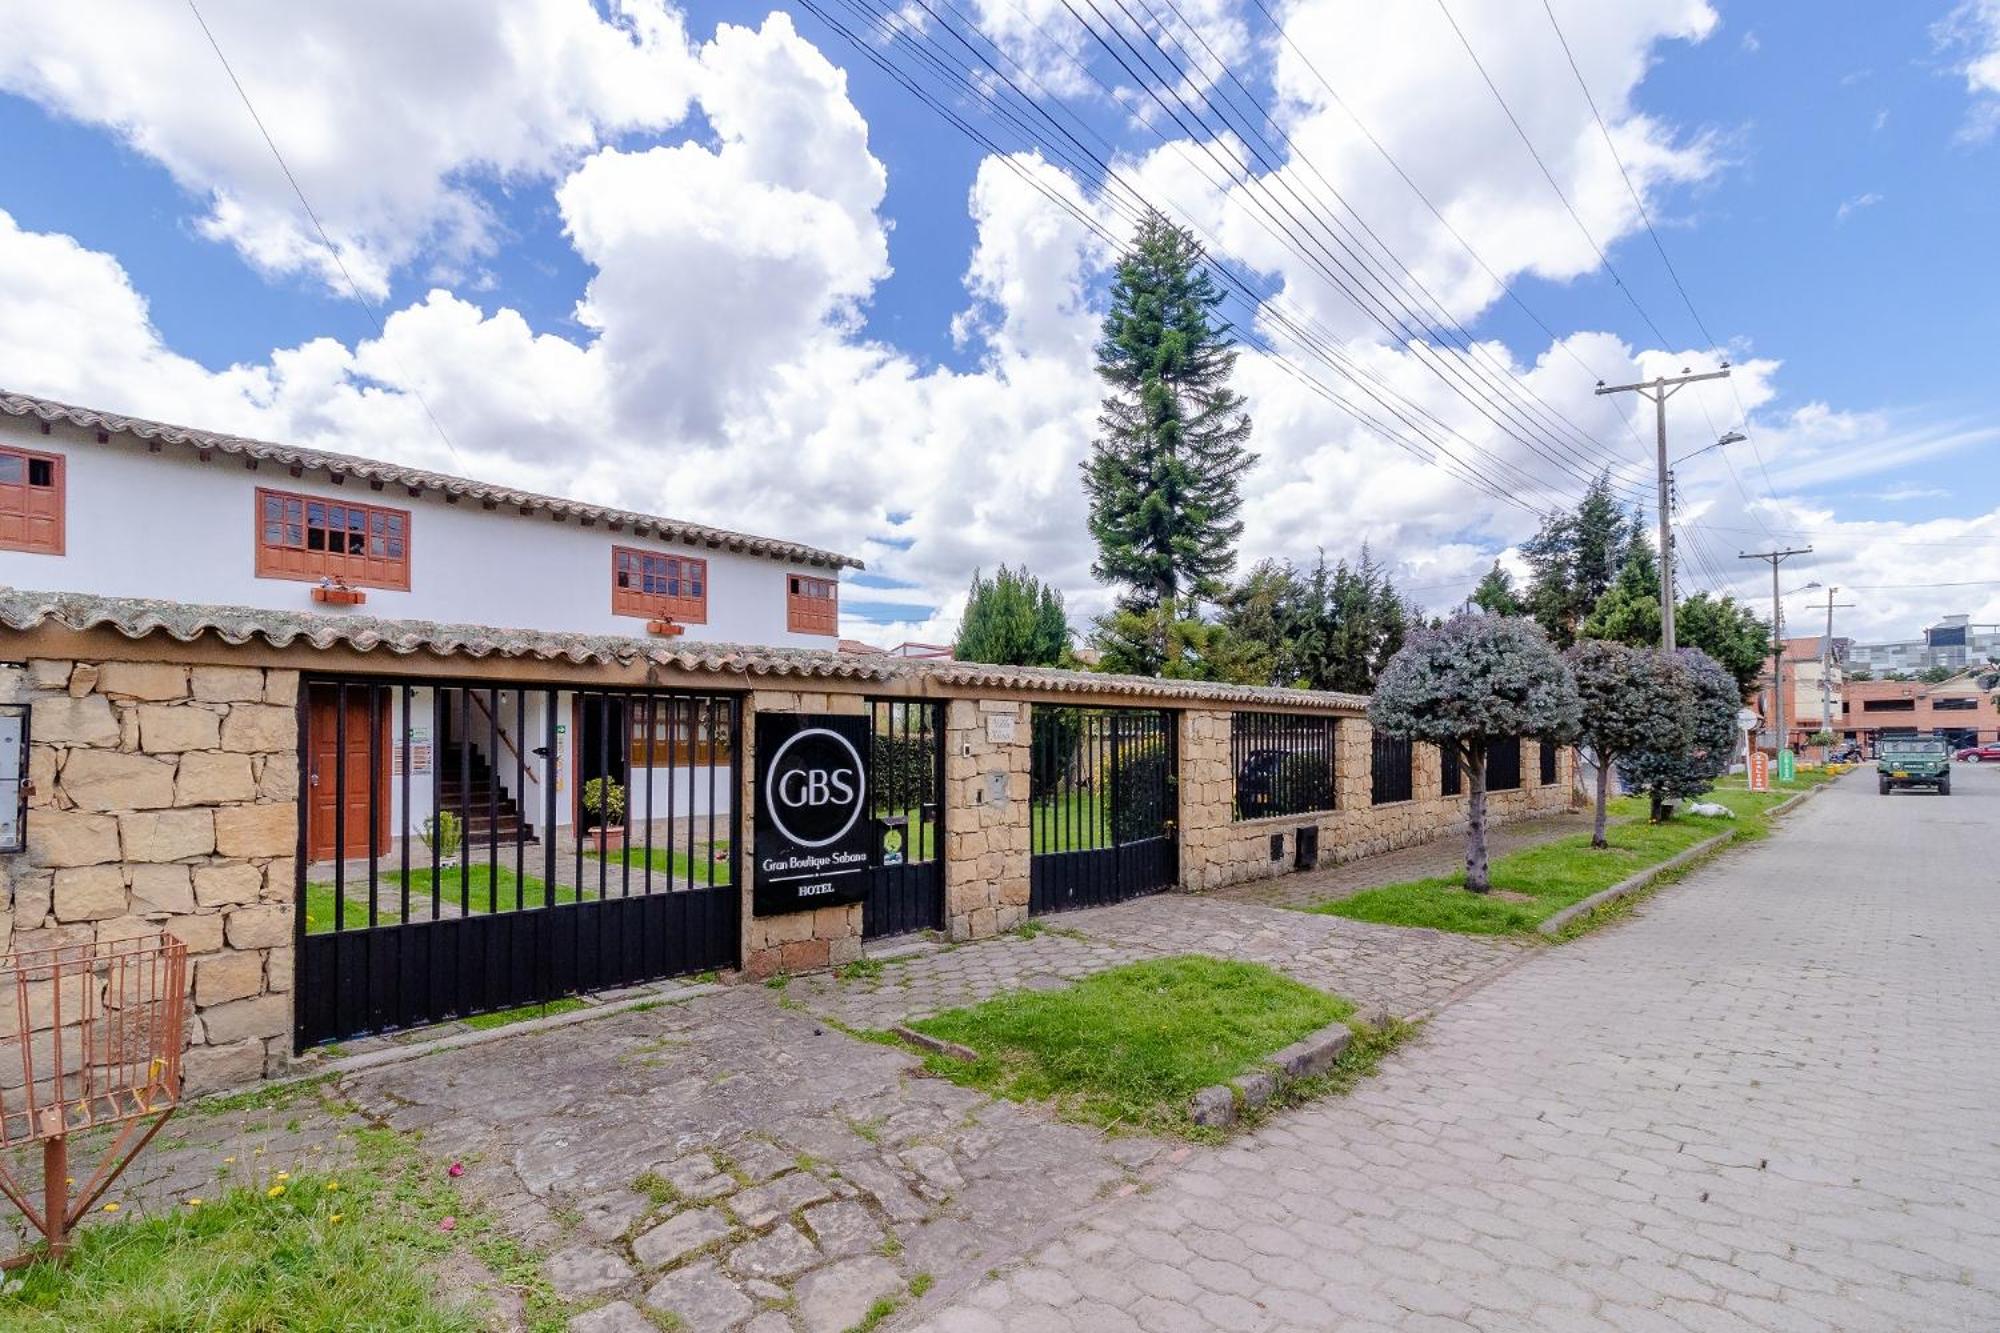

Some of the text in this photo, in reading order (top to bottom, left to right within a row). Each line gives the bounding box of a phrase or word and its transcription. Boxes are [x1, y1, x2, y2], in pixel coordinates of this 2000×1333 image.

[779, 768, 853, 807] GBS
[762, 851, 867, 872] Gran Boutique Sabana
[798, 883, 835, 896] HOTEL
